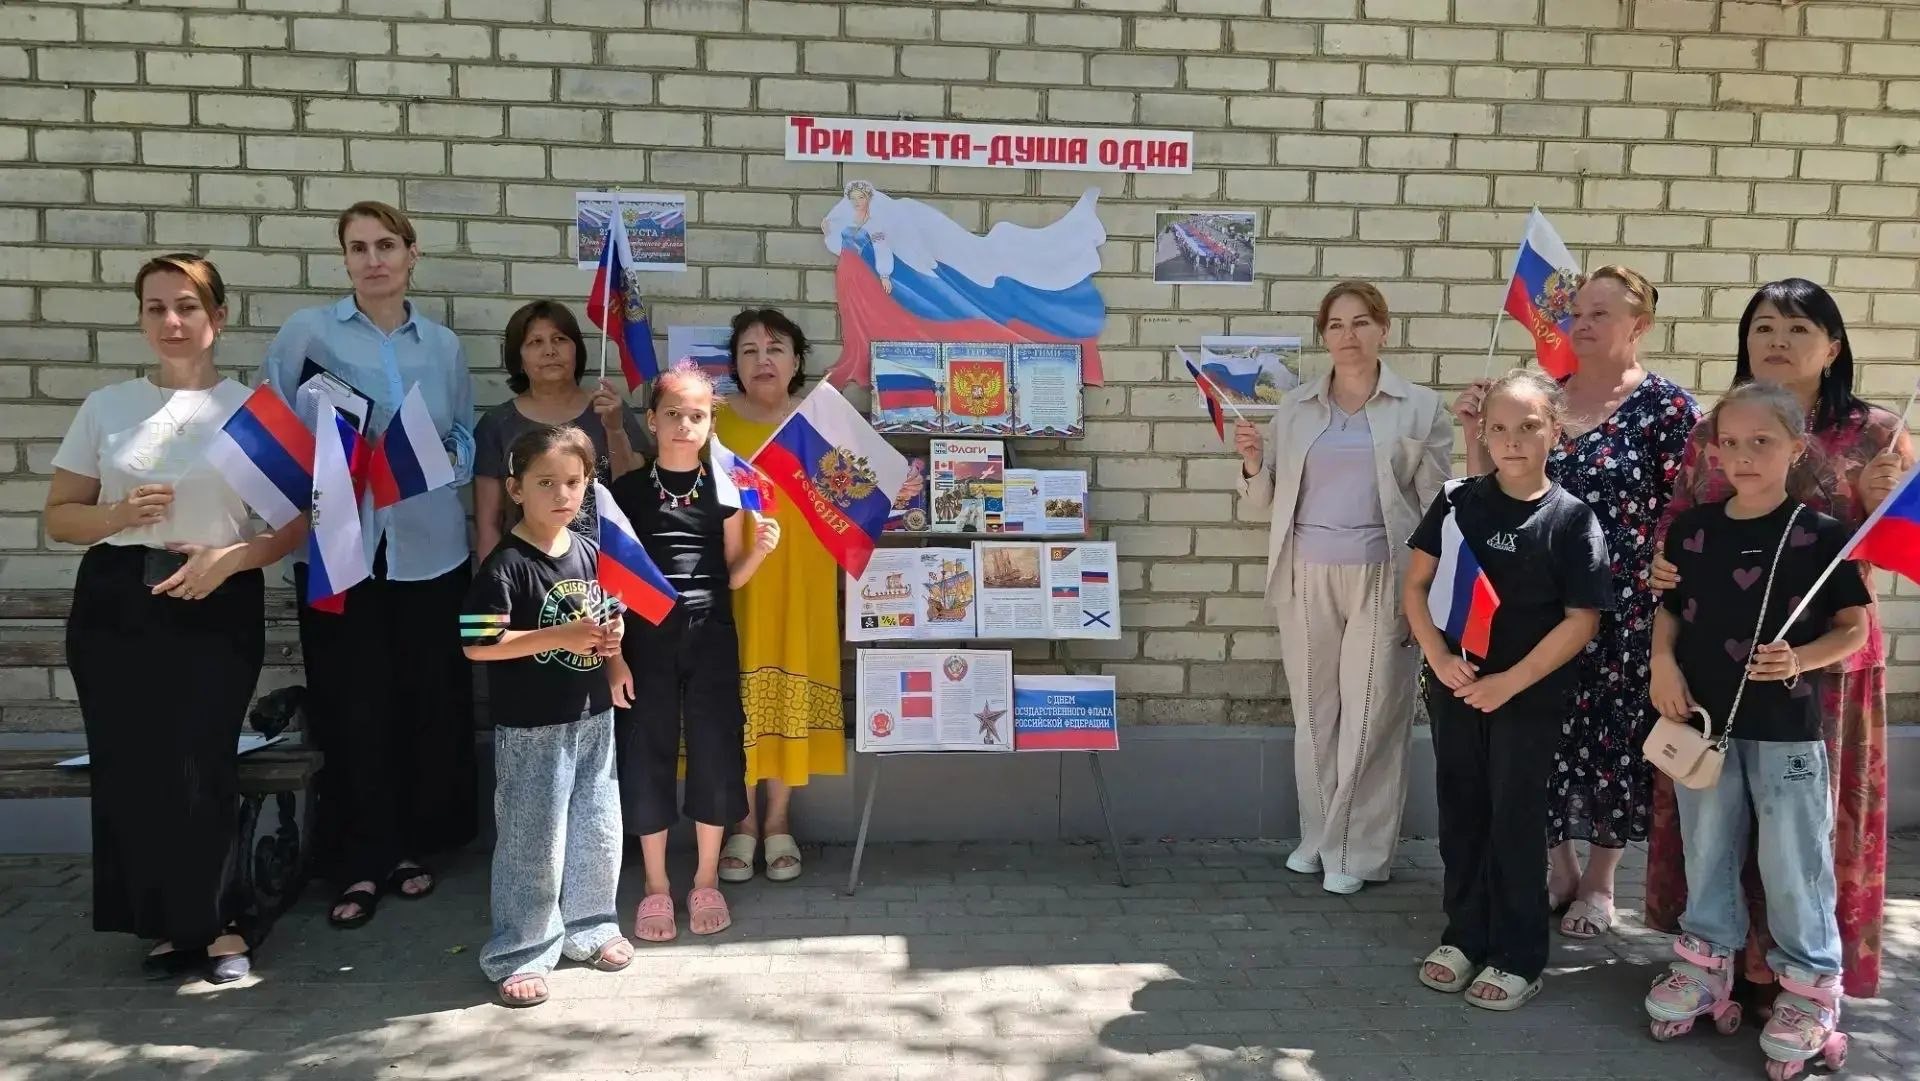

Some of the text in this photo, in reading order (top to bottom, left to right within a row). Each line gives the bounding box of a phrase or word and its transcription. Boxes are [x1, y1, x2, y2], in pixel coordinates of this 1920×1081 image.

[626, 228, 659, 237] ГУСТА
[948, 443, 987, 454] Флаги
[792, 469, 851, 536] РОССИЯ
[1047, 695, 1076, 705] С ДНЕМ
[1014, 706, 1113, 717] ОСУДАРСТВЕННОГО ФЛАГА
[1064, 719, 1110, 729] ФЕДЕРАЦИИ
